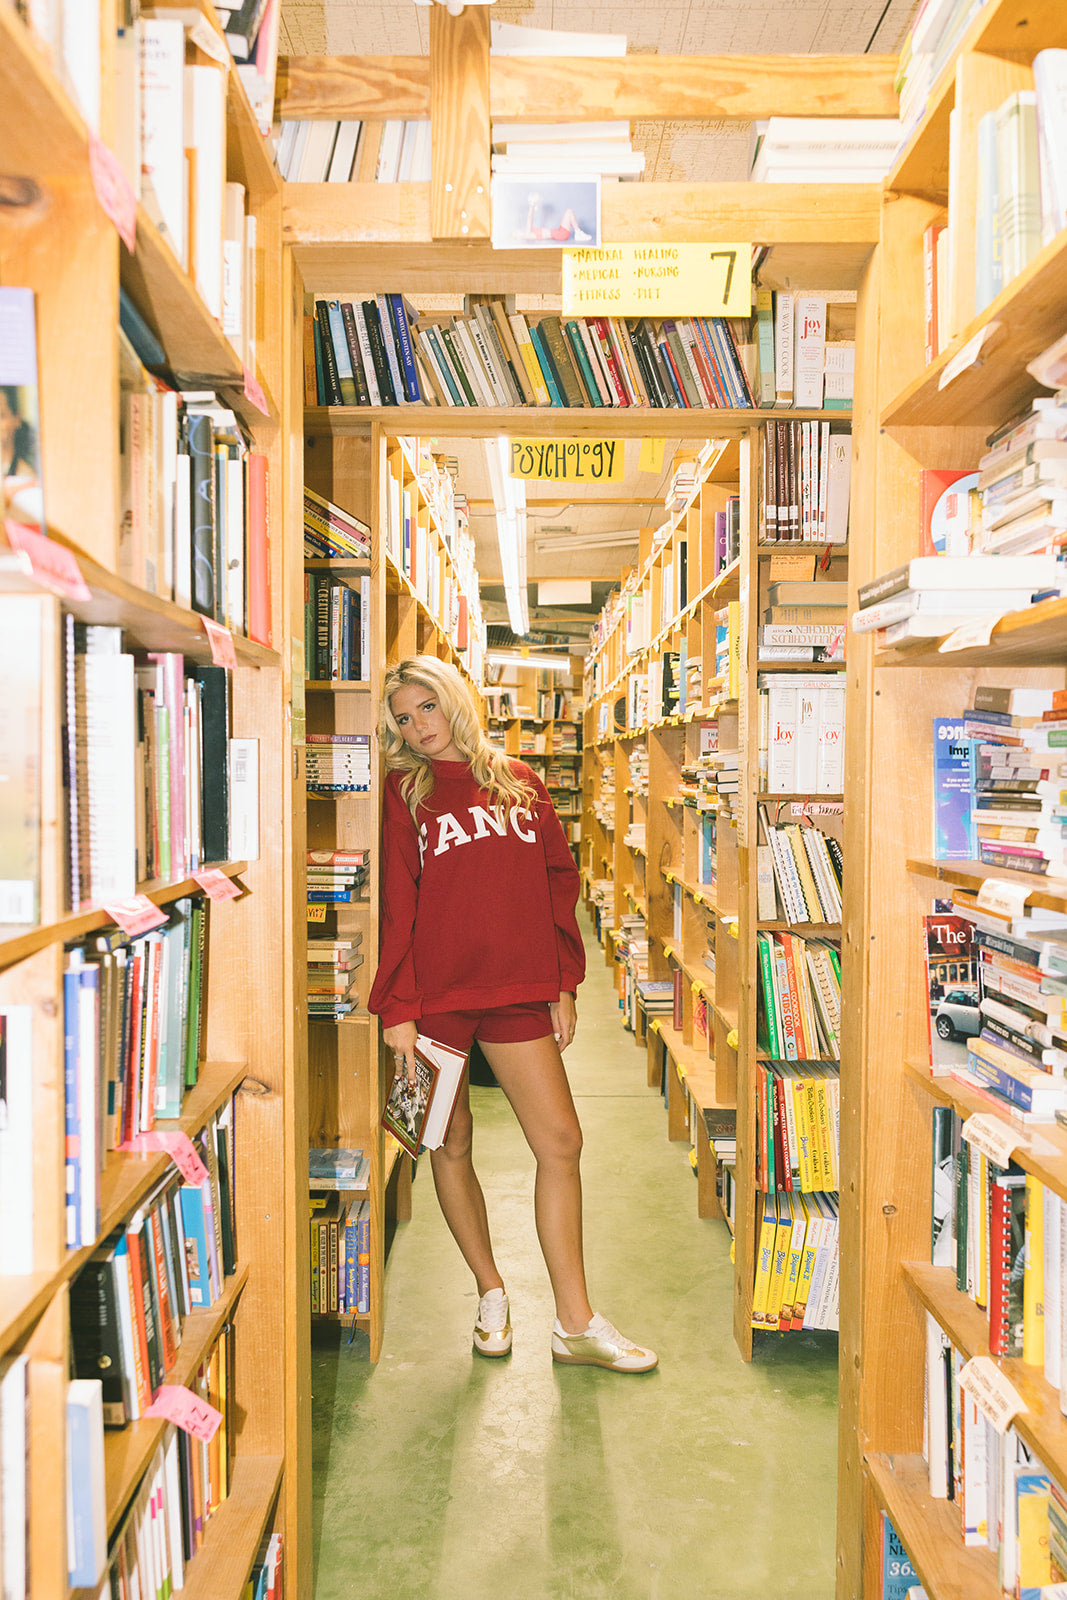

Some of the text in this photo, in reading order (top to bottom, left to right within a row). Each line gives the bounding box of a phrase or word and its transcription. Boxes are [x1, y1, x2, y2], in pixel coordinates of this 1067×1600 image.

[577, 248, 737, 305] NATURAL HEALING 7
[578, 266, 680, 280] MEDICAL NURSING
[579, 287, 661, 300] FITNESS DIET
[781, 312, 789, 333] WAY
[781, 336, 789, 348] TO
[781, 350, 789, 376] COOK
[327, 361, 337, 390] WILLIAMS
[317, 588, 328, 624] CREATIVE
[317, 625, 328, 646] MIND
[794, 621, 838, 637] KITCHEN
[333, 734, 353, 742] GILBERT
[932, 924, 967, 944] The
[781, 992, 794, 1038] KIDS COOK
[789, 990, 801, 1027] COOKBOOK
[783, 1151, 791, 1178] COOKBOOK
[772, 1249, 786, 1275] Bisquick
[788, 1252, 799, 1275] Bisquick
[802, 1250, 815, 1273] Bisquick
